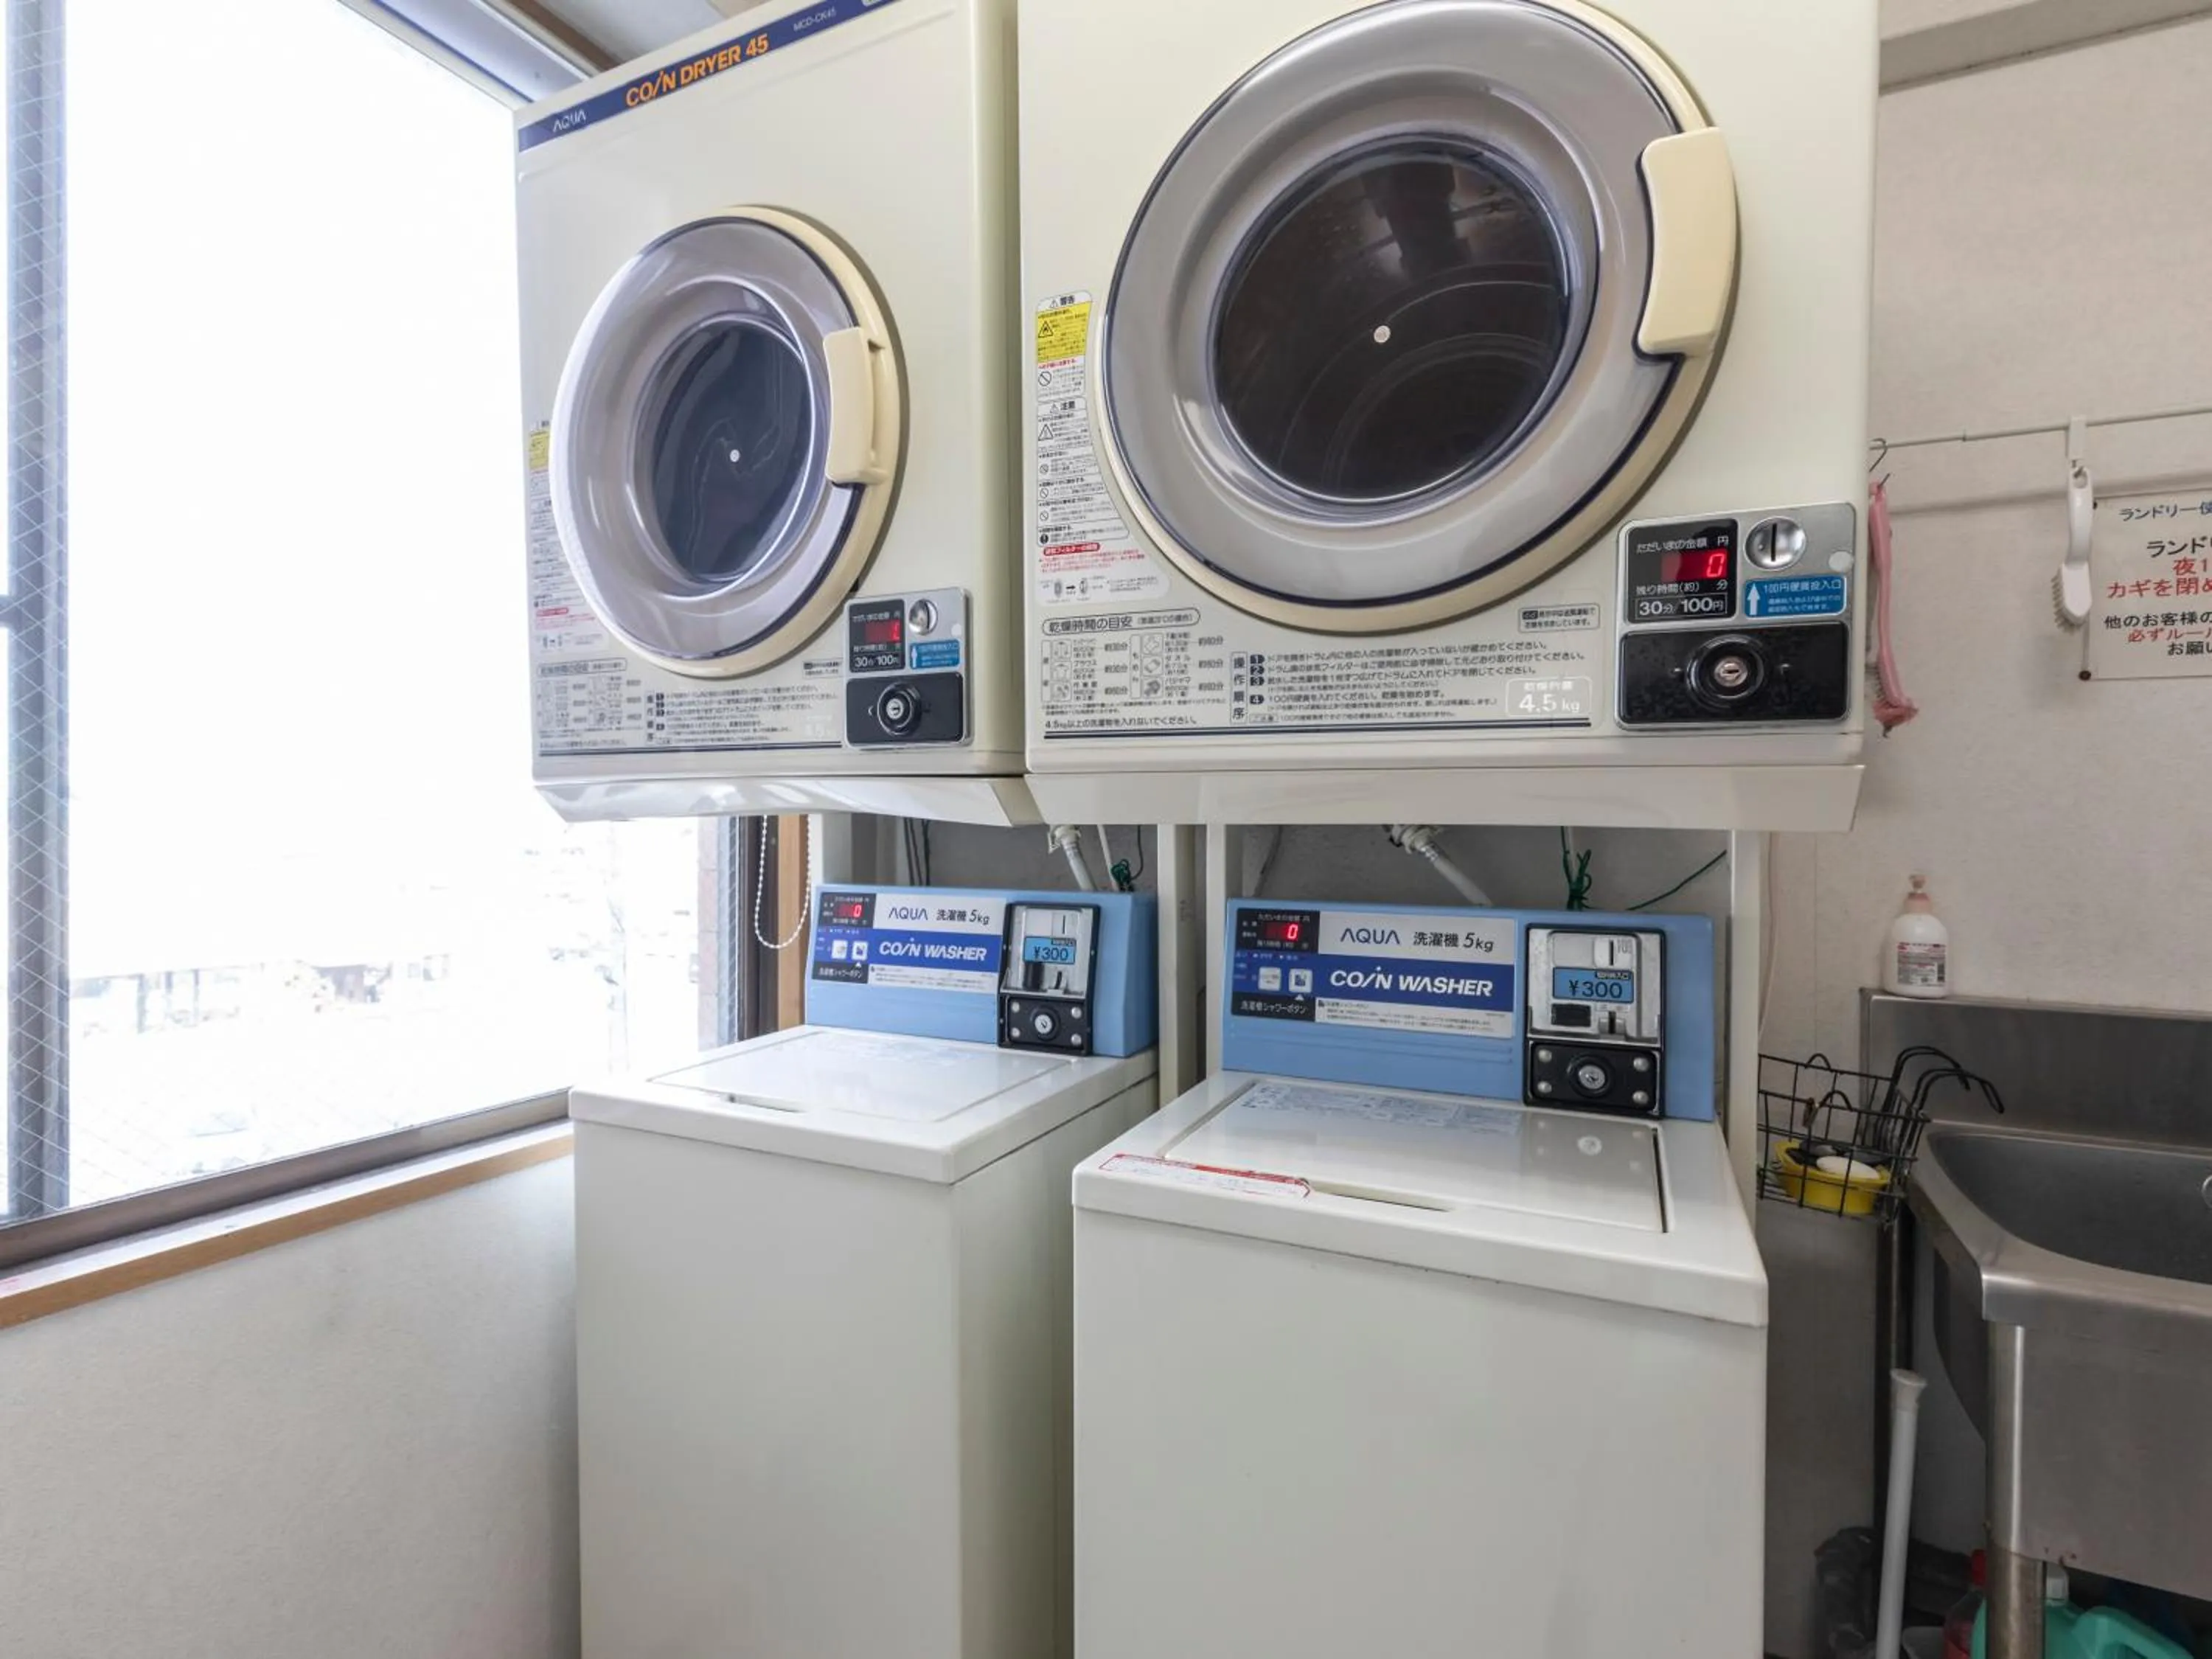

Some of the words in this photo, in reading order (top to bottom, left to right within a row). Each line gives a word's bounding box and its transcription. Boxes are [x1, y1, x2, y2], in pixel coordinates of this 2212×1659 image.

[680, 44, 741, 86] DRYER
[745, 33, 770, 55] 45
[552, 109, 586, 133] AQUA
[1717, 536, 1729, 546] 円
[2146, 536, 2212, 558] ランド
[1706, 553, 1725, 577] 0
[1716, 580, 1728, 591] 分
[1519, 693, 1557, 712] 4.5
[1562, 698, 1580, 713] kg
[852, 905, 862, 917] 0
[888, 907, 928, 920] AQUA
[936, 908, 967, 922] 洗濯機
[969, 909, 990, 925] 5kg
[1287, 923, 1298, 939] 0
[1340, 928, 1400, 945] AQUA
[1413, 931, 1458, 948] 洗濯機
[1463, 932, 1494, 953] 5kg
[925, 943, 987, 961] WASHER
[1033, 945, 1069, 961] ¥300
[1398, 975, 1493, 997] WASHER
[1569, 979, 1622, 999] ¥300
